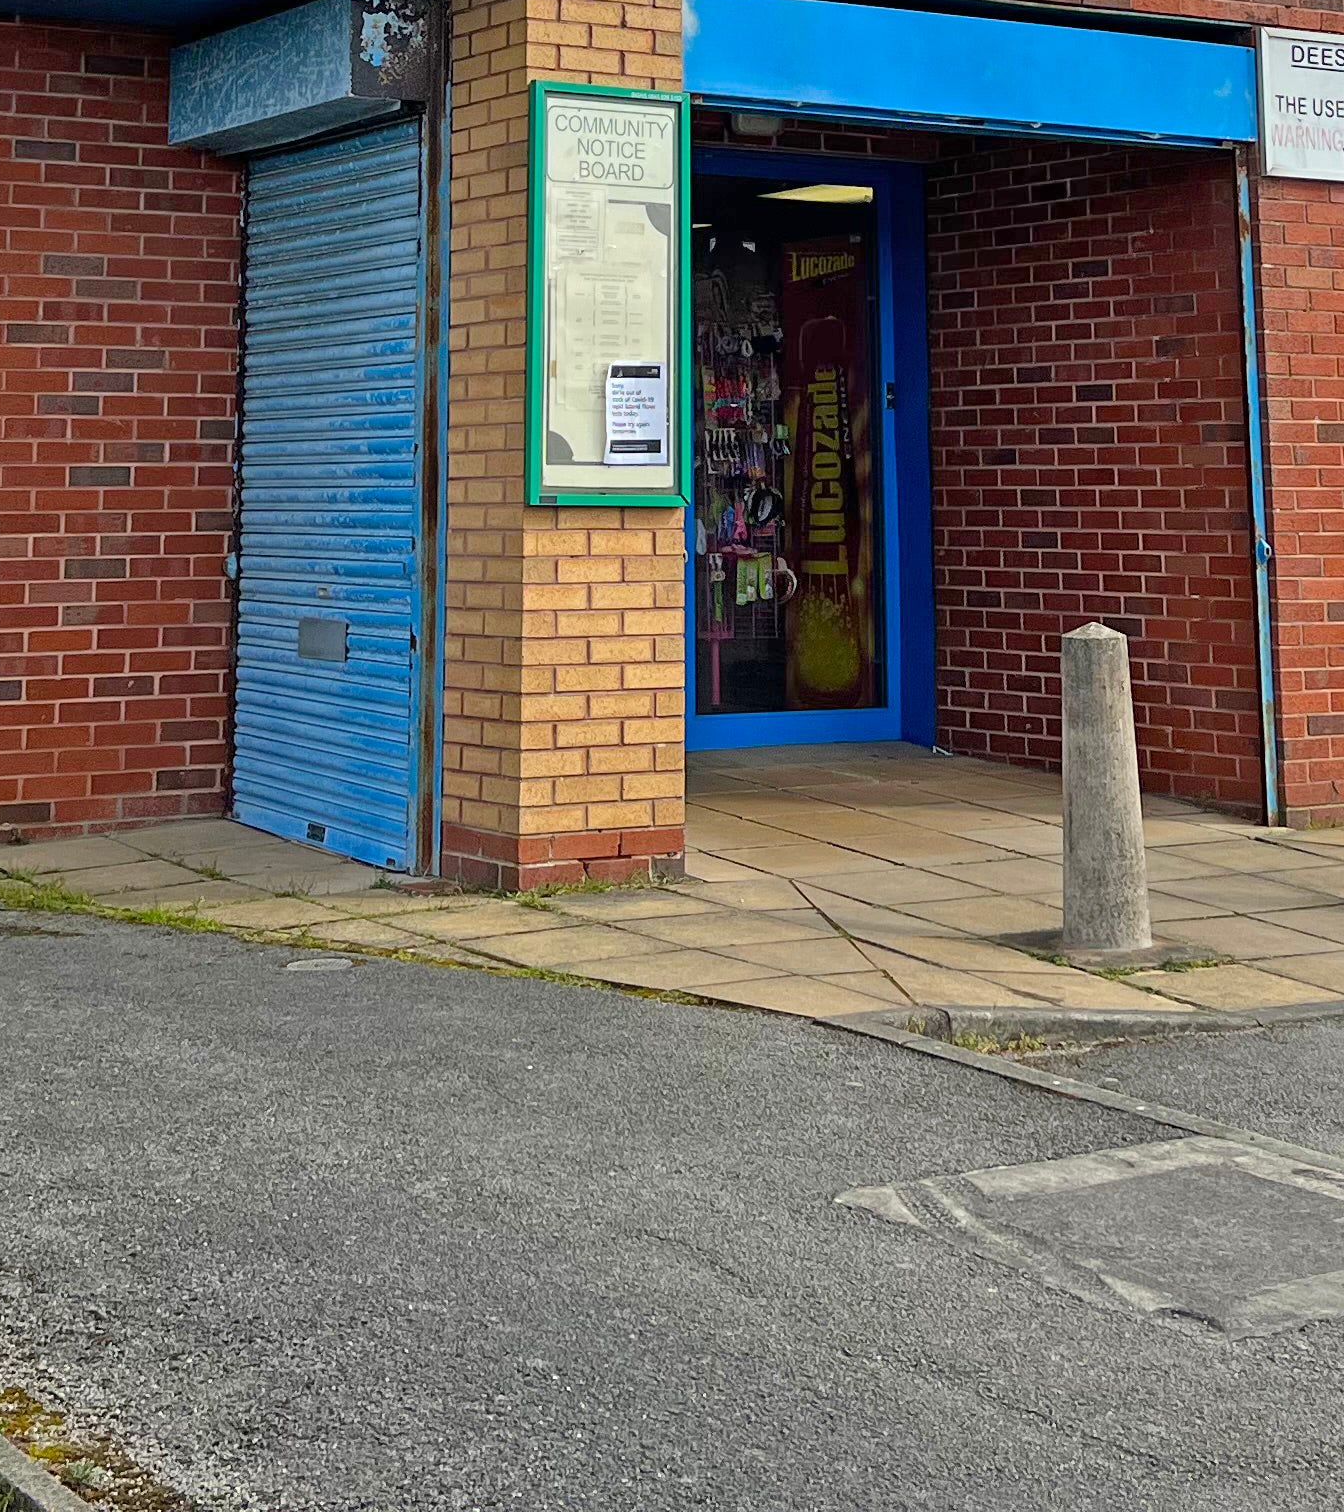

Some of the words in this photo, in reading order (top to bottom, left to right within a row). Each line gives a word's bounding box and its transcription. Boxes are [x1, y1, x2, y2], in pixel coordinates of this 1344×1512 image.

[1275, 94, 1307, 115] THE
[1313, 98, 1344, 118] USE
[555, 114, 668, 139] COMMUNITY
[1271, 124, 1344, 152] WARNING
[577, 137, 646, 160] NOTICE
[579, 160, 644, 181] BOARD
[792, 251, 855, 281] Lucozade
[800, 365, 849, 575] Lucozade
